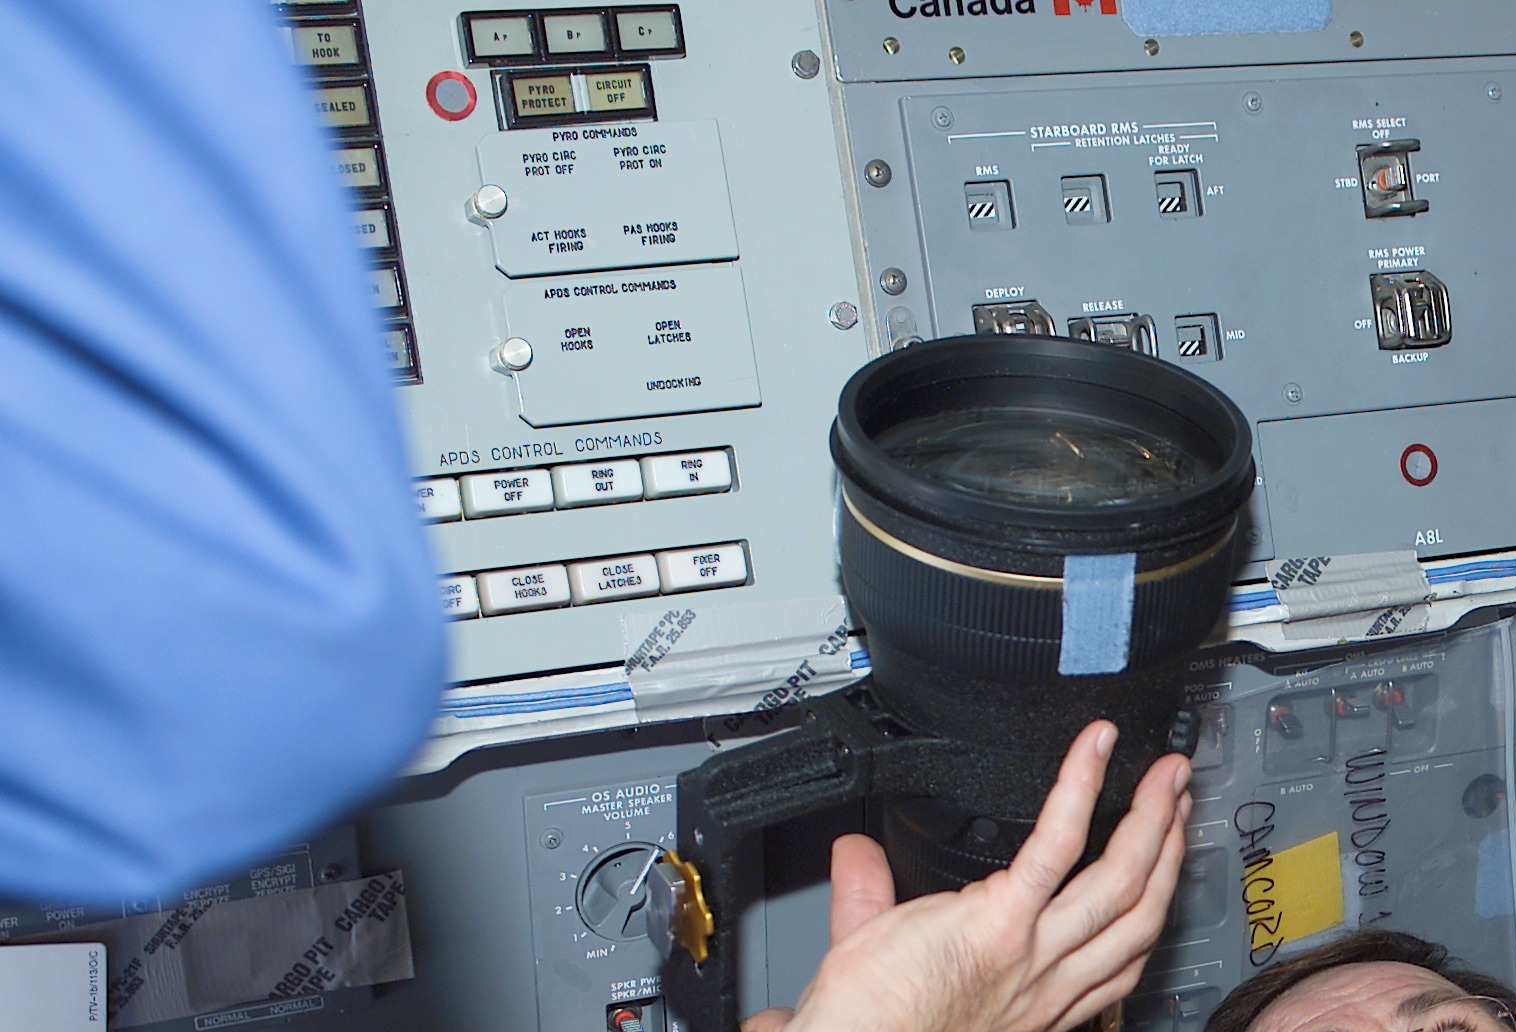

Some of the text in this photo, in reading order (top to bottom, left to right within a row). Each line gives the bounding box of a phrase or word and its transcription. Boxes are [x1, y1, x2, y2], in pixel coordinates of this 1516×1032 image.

[317, 33, 331, 43] TO
[312, 47, 340, 58] HOOK
[528, 84, 555, 96] PYRO
[596, 79, 632, 91] CIRCUIT
[522, 97, 567, 109] PROTECT
[607, 93, 626, 104] OFF
[1352, 117, 1407, 129] RMS SELECT
[552, 127, 638, 142] PYRO COMMANDS
[1030, 121, 1139, 139] STARBOARD RMS
[1372, 129, 1390, 139] OFF
[1075, 133, 1176, 148] RETENTION LATCHES
[613, 144, 667, 157] PYRO CIRC
[1158, 143, 1190, 155] READY
[522, 150, 577, 164] PYRO CIRC
[1148, 154, 1204, 166] FOR LATCH
[620, 157, 663, 171] PROT ON
[525, 164, 574, 177] PROT OFF
[975, 165, 999, 176] RMS
[1335, 178, 1359, 189] STBD
[1416, 173, 1440, 183] PORT
[1206, 185, 1224, 196] AFT
[623, 221, 679, 235] PAS HOOKS
[531, 228, 587, 242] ACT HOOKS
[641, 234, 676, 246] FIRING
[549, 241, 584, 253] FIRING
[1368, 246, 1426, 259] RMS POWER
[1378, 258, 1419, 269] PRIMARY
[544, 280, 677, 299] APDS CONTROL COMMANDS
[985, 286, 1025, 299] DEPLOY
[1082, 300, 1124, 312] RELEASE
[655, 320, 682, 331] OPEN
[1354, 319, 1372, 329] OFF
[564, 327, 591, 339] OPEN
[648, 332, 692, 345] LATCHES
[1226, 329, 1246, 340] MID
[561, 340, 594, 351] HOOKS
[1392, 352, 1429, 364] BACKUP
[646, 376, 702, 391] UNDOCKING
[439, 431, 664, 467] APDS CONTROL COMMANDS
[680, 459, 703, 470] RING
[591, 468, 615, 480] RING
[689, 472, 699, 483] IN
[494, 478, 529, 489] POWER
[595, 480, 614, 492] OUT
[504, 491, 523, 502] OFF
[1415, 528, 1444, 546] A8L
[693, 553, 721, 565] FIXER
[602, 563, 635, 576] CLOSE
[700, 566, 719, 578] OFF
[1297, 556, 1331, 586] TAPE
[511, 574, 545, 586] CLOSE
[598, 576, 643, 591] LATCHES
[515, 587, 548, 599] HOOKS
[666, 608, 697, 644] 25.853
[1410, 660, 1435, 671] AUTO
[786, 659, 817, 690] PIT
[1361, 667, 1386, 679] AUTO
[1413, 764, 1430, 774] OFF
[591, 783, 661, 802] OS AUDIO
[1288, 783, 1314, 794] AUTO
[581, 793, 673, 815] MASTER SPEAKER
[603, 806, 650, 821] VOLUME
[625, 821, 631, 830] 5
[1343, 750, 1392, 897] WINDOW
[667, 832, 675, 840] 6
[582, 844, 589, 852] 4
[559, 873, 567, 881] 3
[1234, 801, 1285, 967] CAMCORD
[335, 877, 386, 933] CARGO
[555, 906, 562, 915] 2
[573, 933, 578, 942] 1
[304, 936, 334, 965] PIT
[586, 948, 608, 960] MIN
[611, 979, 636, 992] SPKR
[270, 1000, 317, 1015] NORMAL
[203, 1011, 250, 1027] NORMAL
